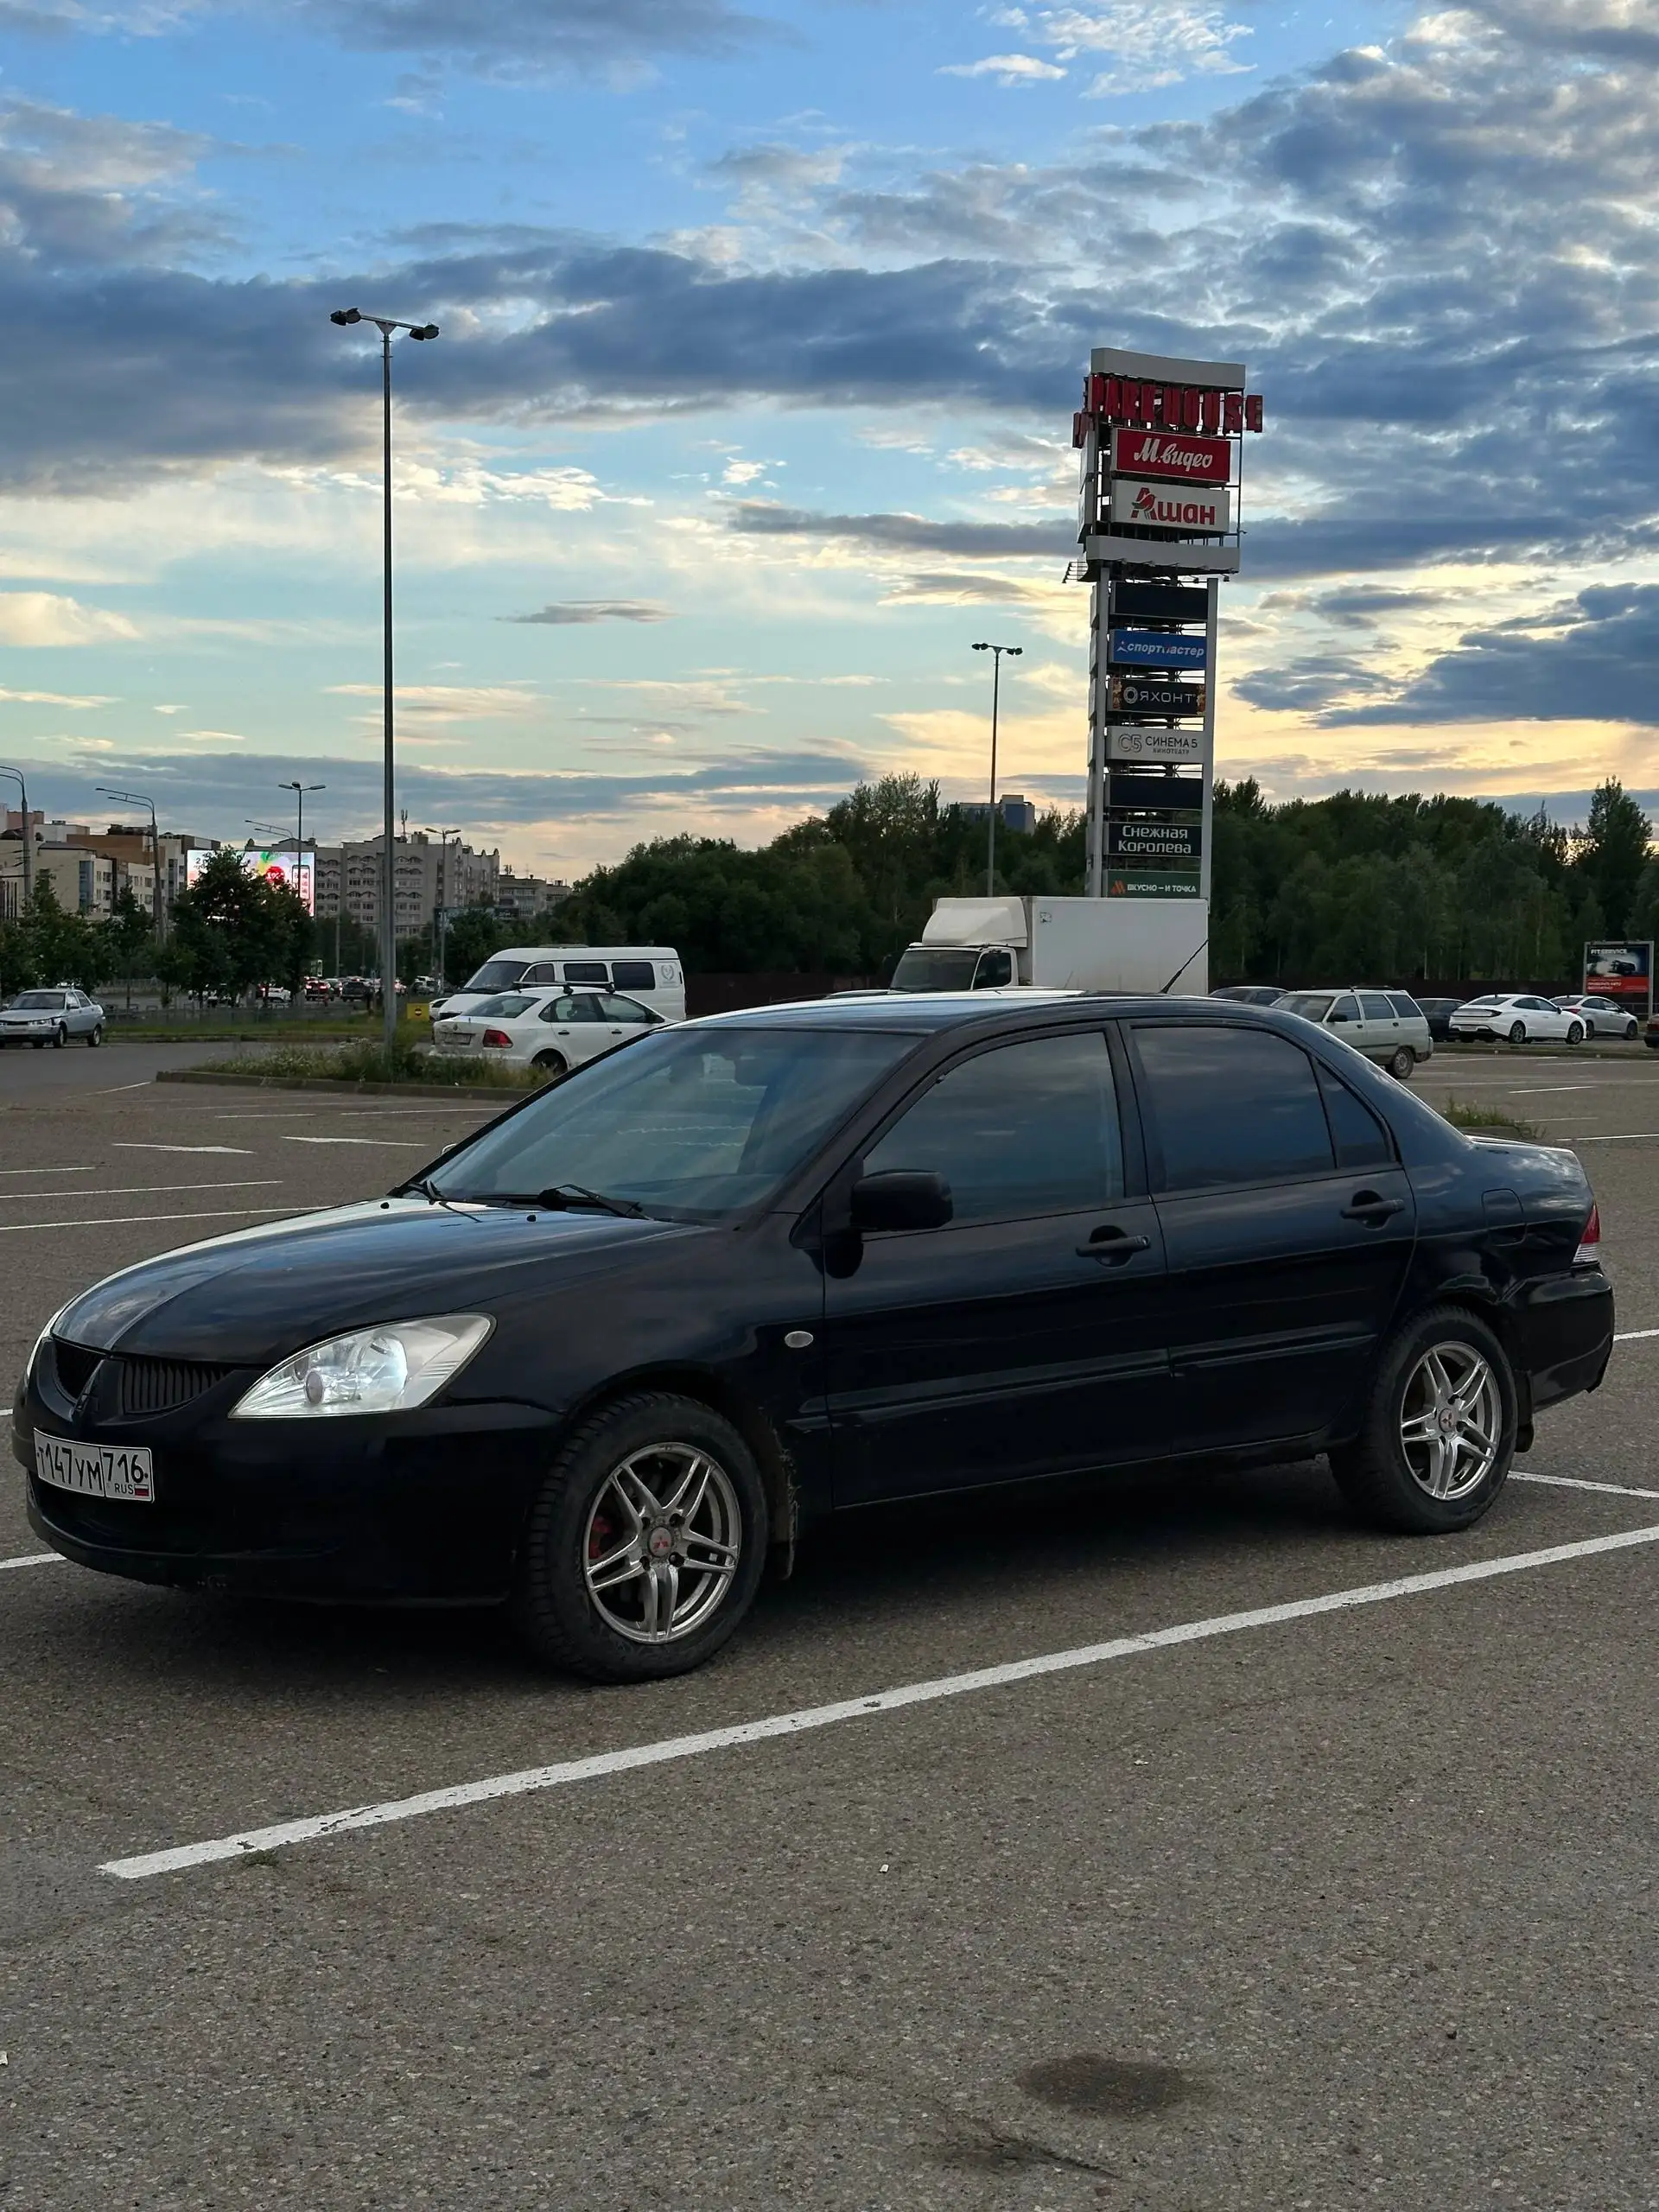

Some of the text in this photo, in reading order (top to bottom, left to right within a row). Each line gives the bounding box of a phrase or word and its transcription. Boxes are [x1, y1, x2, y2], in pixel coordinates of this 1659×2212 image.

[1140, 690, 1192, 704] ЯХОНТ
[1145, 735, 1198, 748] СИНЕМА 5
[1122, 825, 1188, 839] Снежная
[1117, 840, 1192, 854] Королева
[103, 1452, 143, 1484] 716
[114, 1483, 134, 1495] RUS
